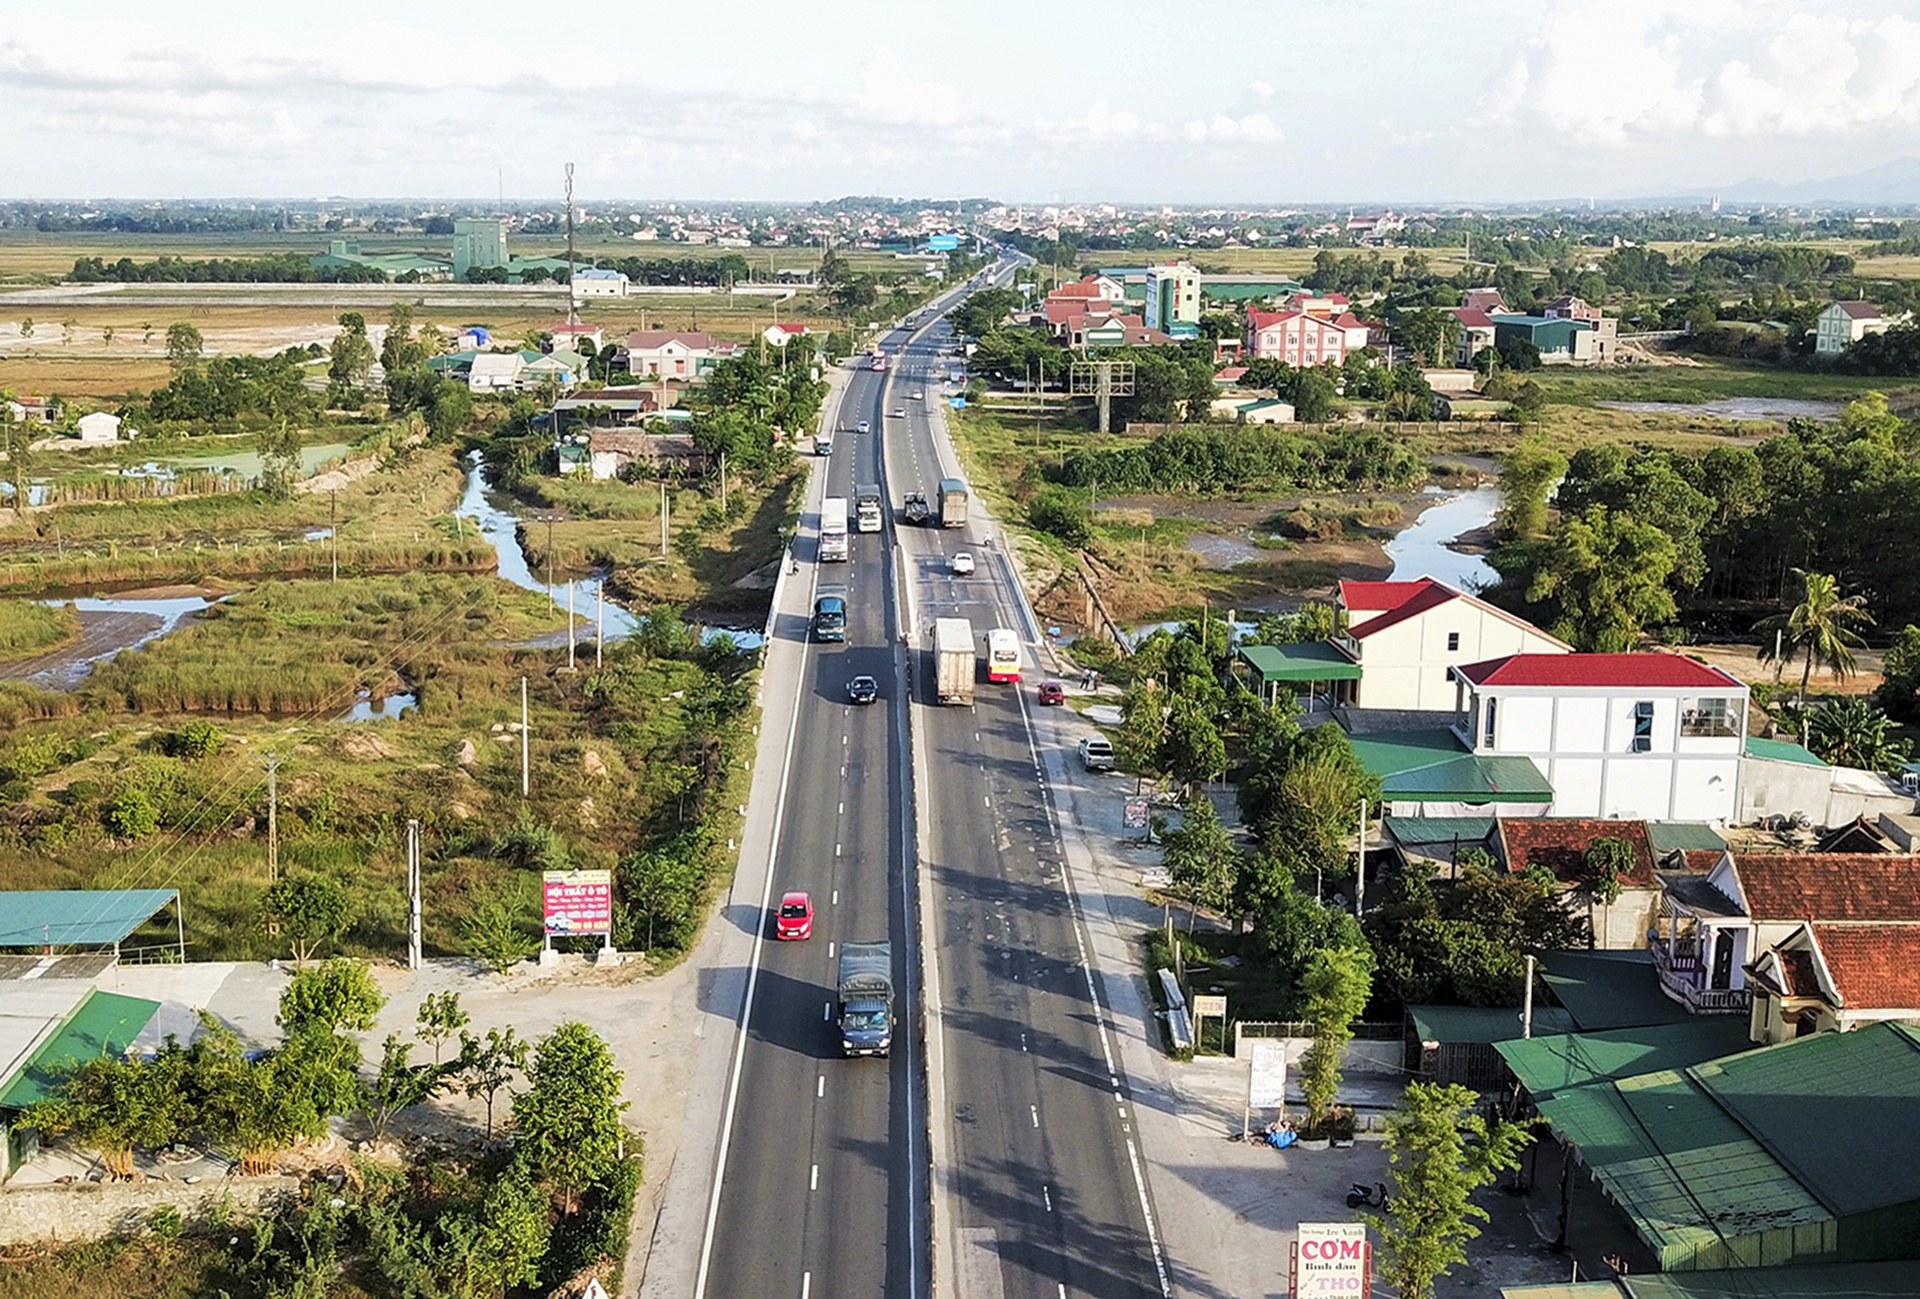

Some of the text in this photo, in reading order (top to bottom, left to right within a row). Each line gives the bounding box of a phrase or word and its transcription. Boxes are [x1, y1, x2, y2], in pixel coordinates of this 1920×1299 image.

[564, 885, 587, 896] THẤT
[588, 885, 595, 895] Ô
[596, 885, 608, 895] TÔ
[1301, 1238, 1361, 1260] CƠM
